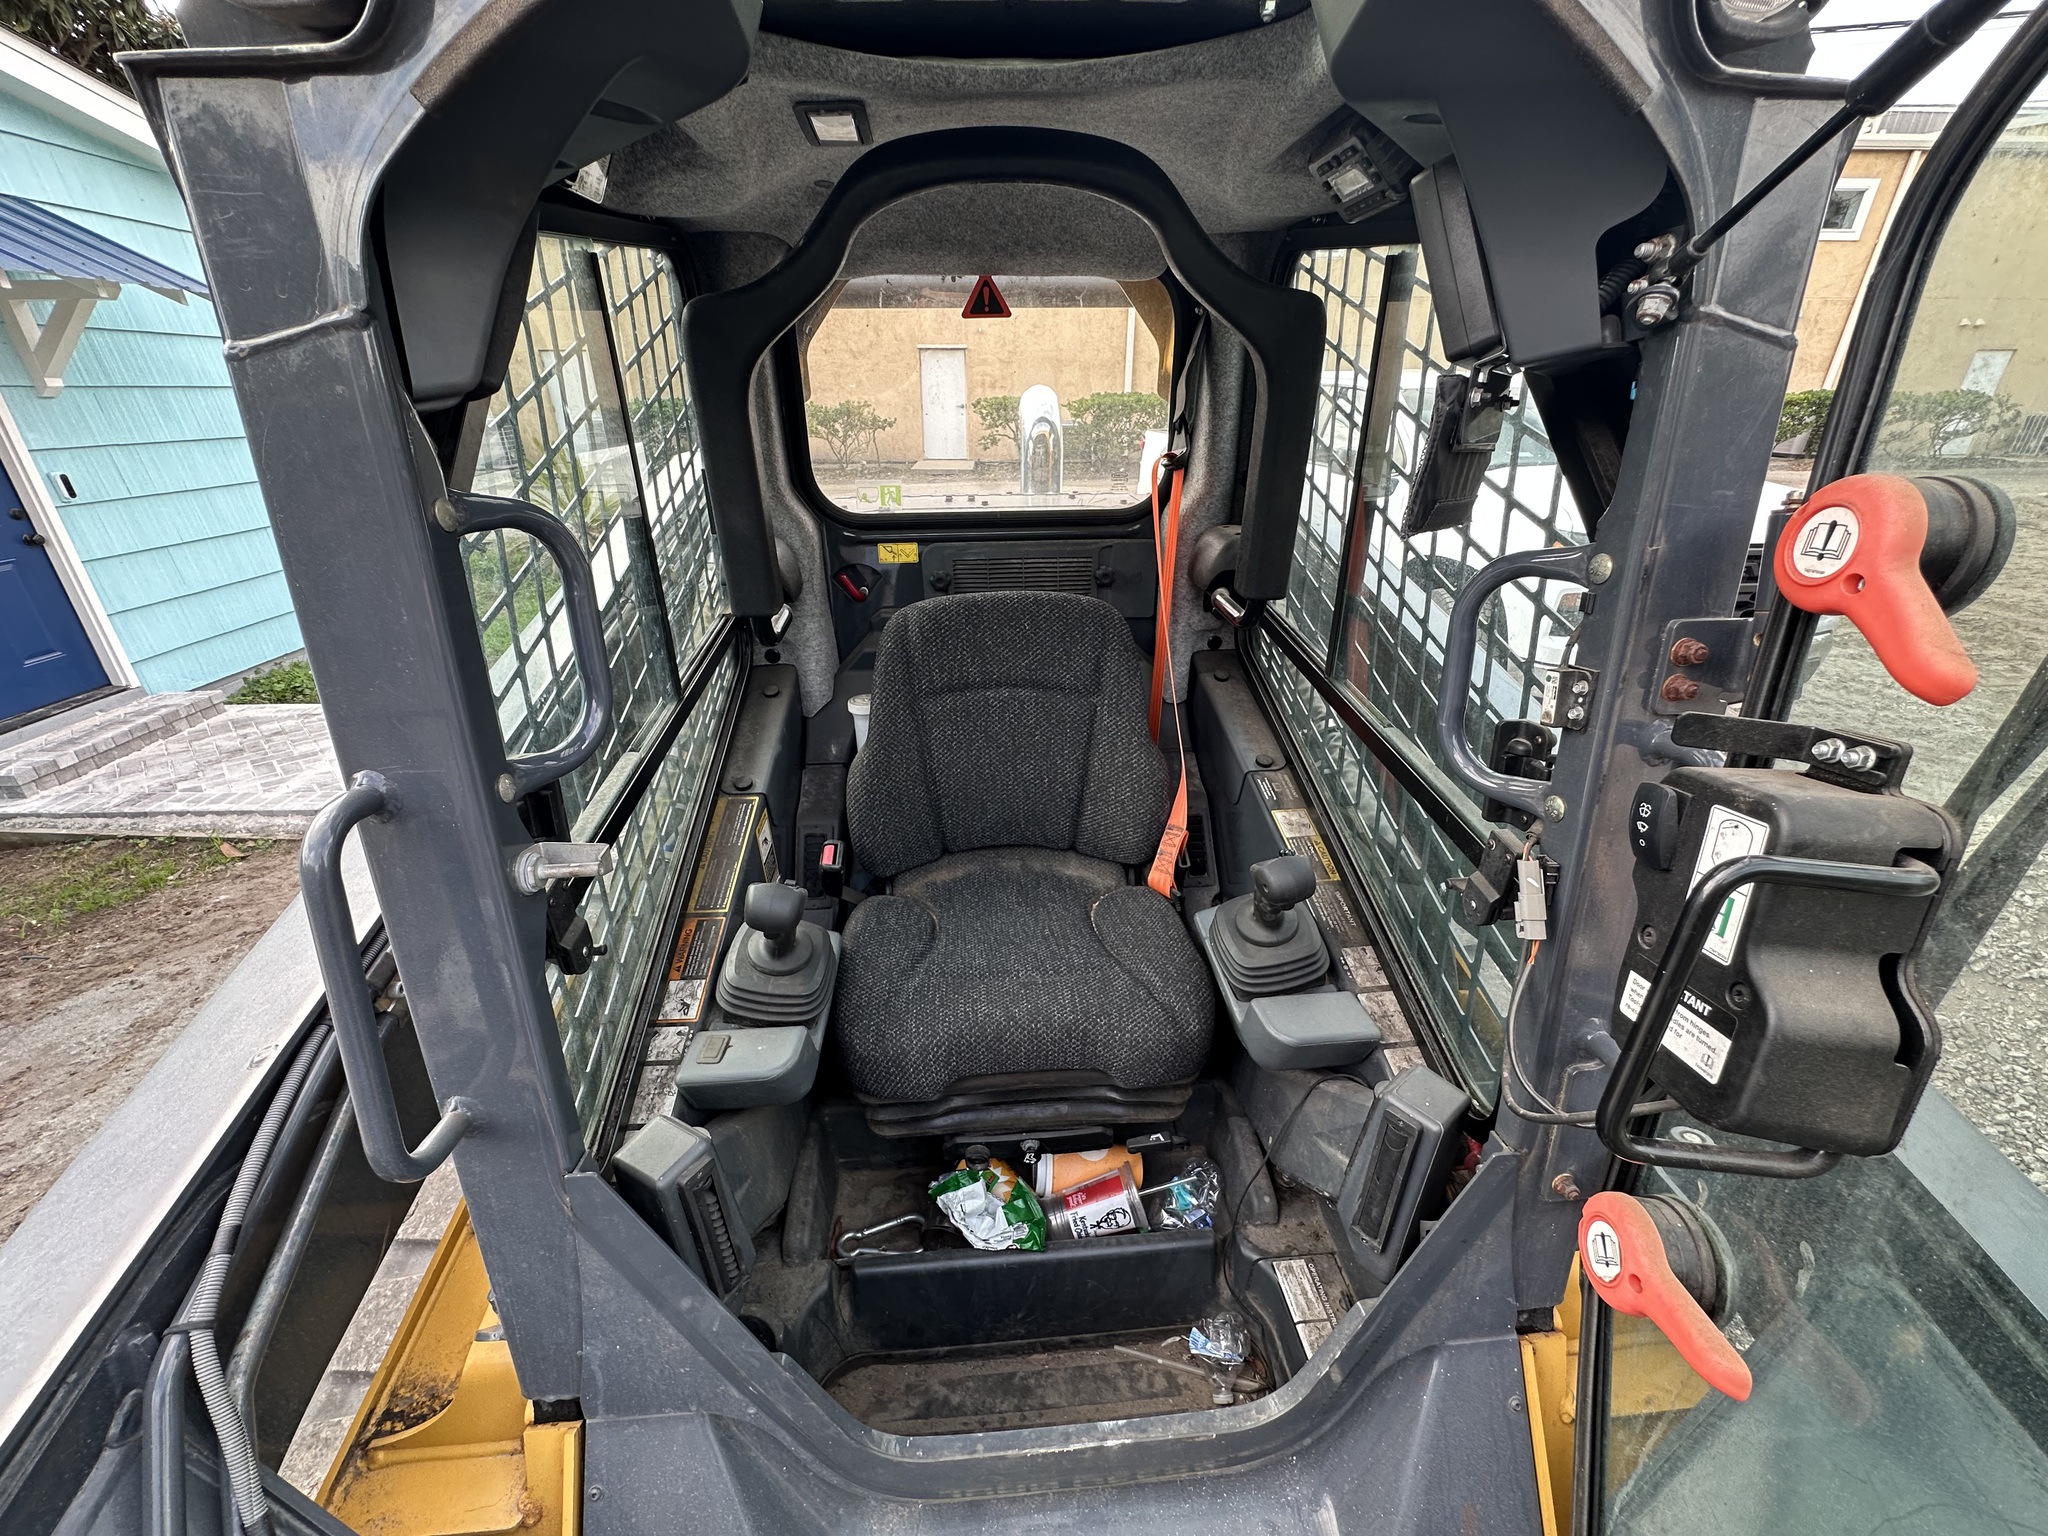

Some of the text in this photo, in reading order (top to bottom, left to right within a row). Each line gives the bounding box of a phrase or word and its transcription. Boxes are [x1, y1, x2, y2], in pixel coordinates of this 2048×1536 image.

[1318, 845, 1337, 875] CAUTION
[1336, 890, 1356, 926] IMPORTANT
[677, 928, 693, 964] WARNING
[1632, 978, 1710, 1039] Door from hinges
[1680, 990, 1713, 1016] TANT
[1672, 1018, 1685, 1032] dles
[1686, 1028, 1696, 1039] are
[1070, 1211, 1080, 1228] Fried
[1308, 1263, 1328, 1301] OPERATING
